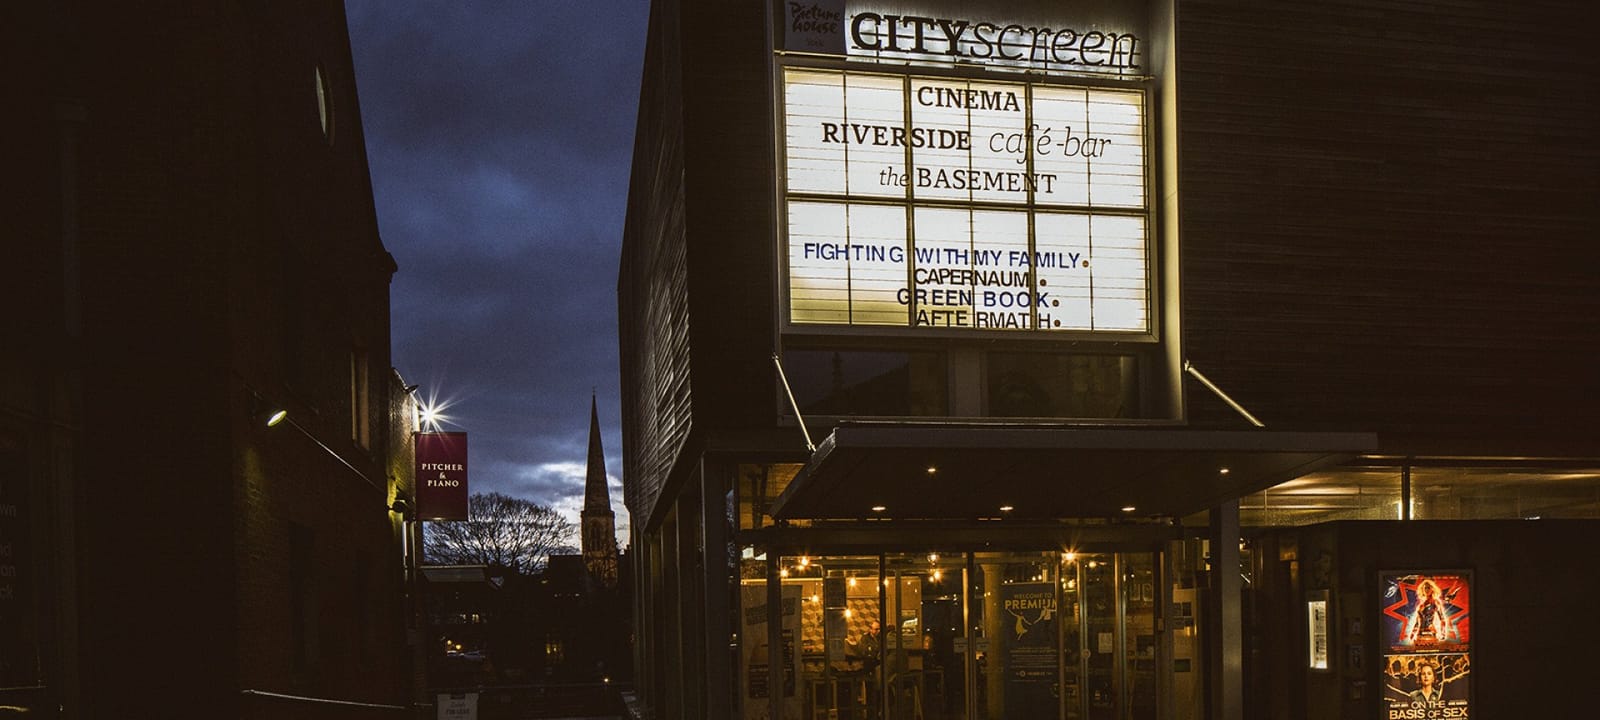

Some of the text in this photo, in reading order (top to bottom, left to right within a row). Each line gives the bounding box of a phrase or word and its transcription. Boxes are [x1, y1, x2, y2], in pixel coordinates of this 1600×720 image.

[789, 2, 841, 21] Picture
[792, 16, 838, 33] house
[917, 86, 1021, 112] CINEMA
[821, 122, 1112, 165] RIVERSIDE café-bar
[879, 166, 1058, 194] the BASEMENT
[803, 243, 1081, 269] FIGHTING WITH MY FAMILY
[914, 268, 1030, 288] CAPERNAUM
[897, 288, 1050, 308] GREEN BOOK
[421, 463, 464, 471] PITCHER
[439, 471, 447, 480] &
[427, 479, 460, 488] PIANO
[1389, 707, 1469, 720] BASIS OF SEX
[1410, 701, 1426, 709] ON
[1428, 700, 1446, 709] THE
